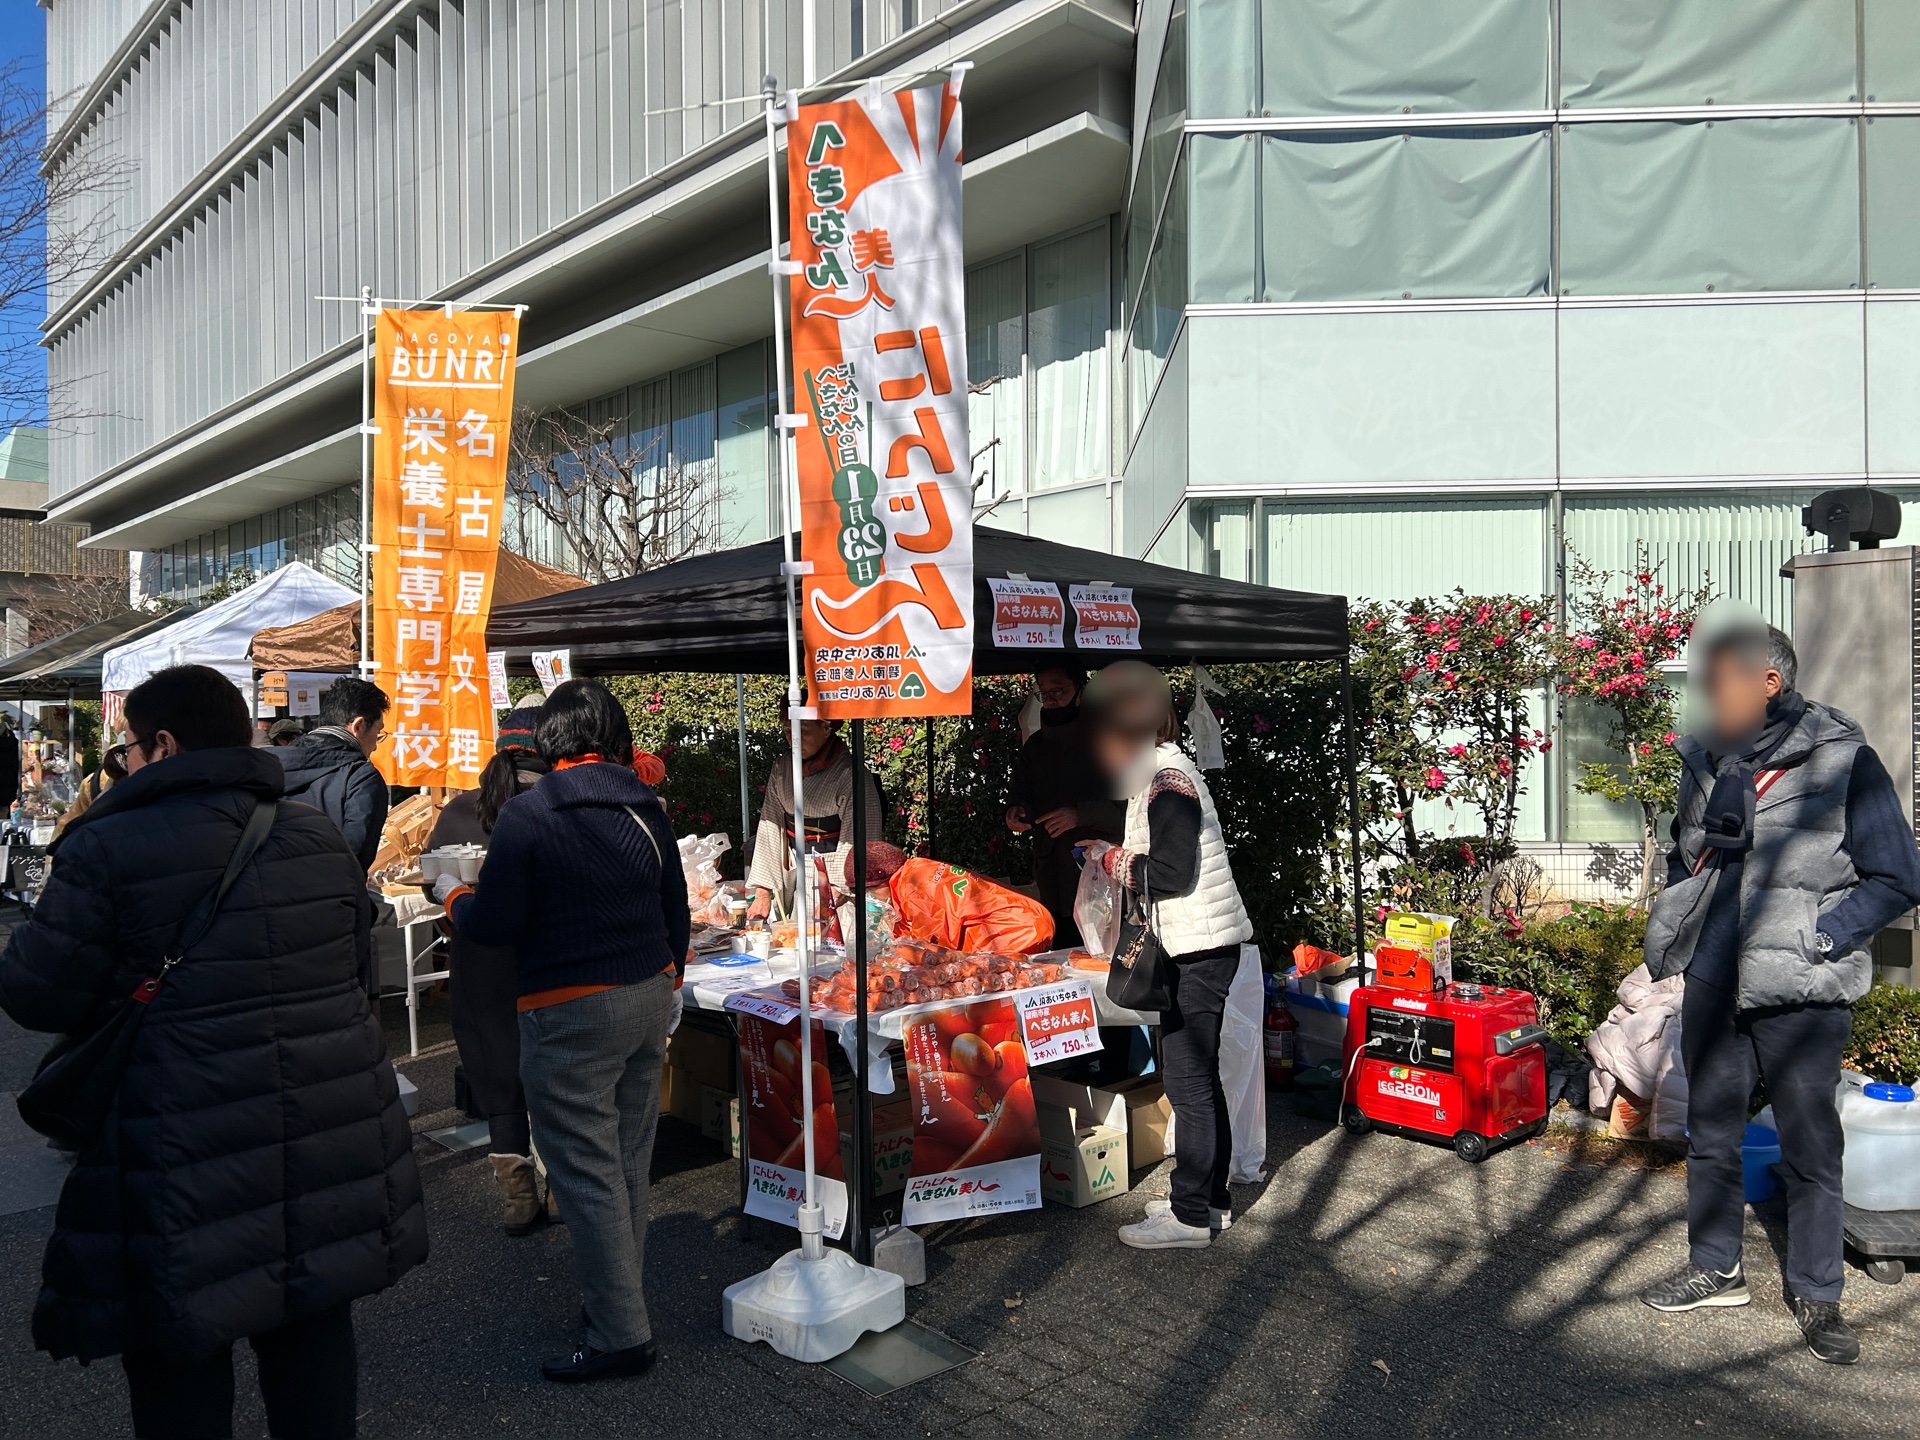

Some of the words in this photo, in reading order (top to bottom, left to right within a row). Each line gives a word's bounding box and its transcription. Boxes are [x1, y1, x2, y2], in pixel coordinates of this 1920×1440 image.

[396, 332, 491, 346] NAGOYA
[391, 407, 447, 771] 栄養士専門学校
[448, 408, 495, 774] 名古屋文理
[1001, 605, 1059, 619] へきなん美人
[1083, 610, 1135, 623] へきなん美人
[1030, 1009, 1091, 1032] へきなん美人
[1033, 1048, 1058, 1061] 3本入り
[753, 1165, 787, 1182] にんじん
[909, 1179, 1001, 1202] へきなん美人
[911, 1176, 960, 1190] にんじん
